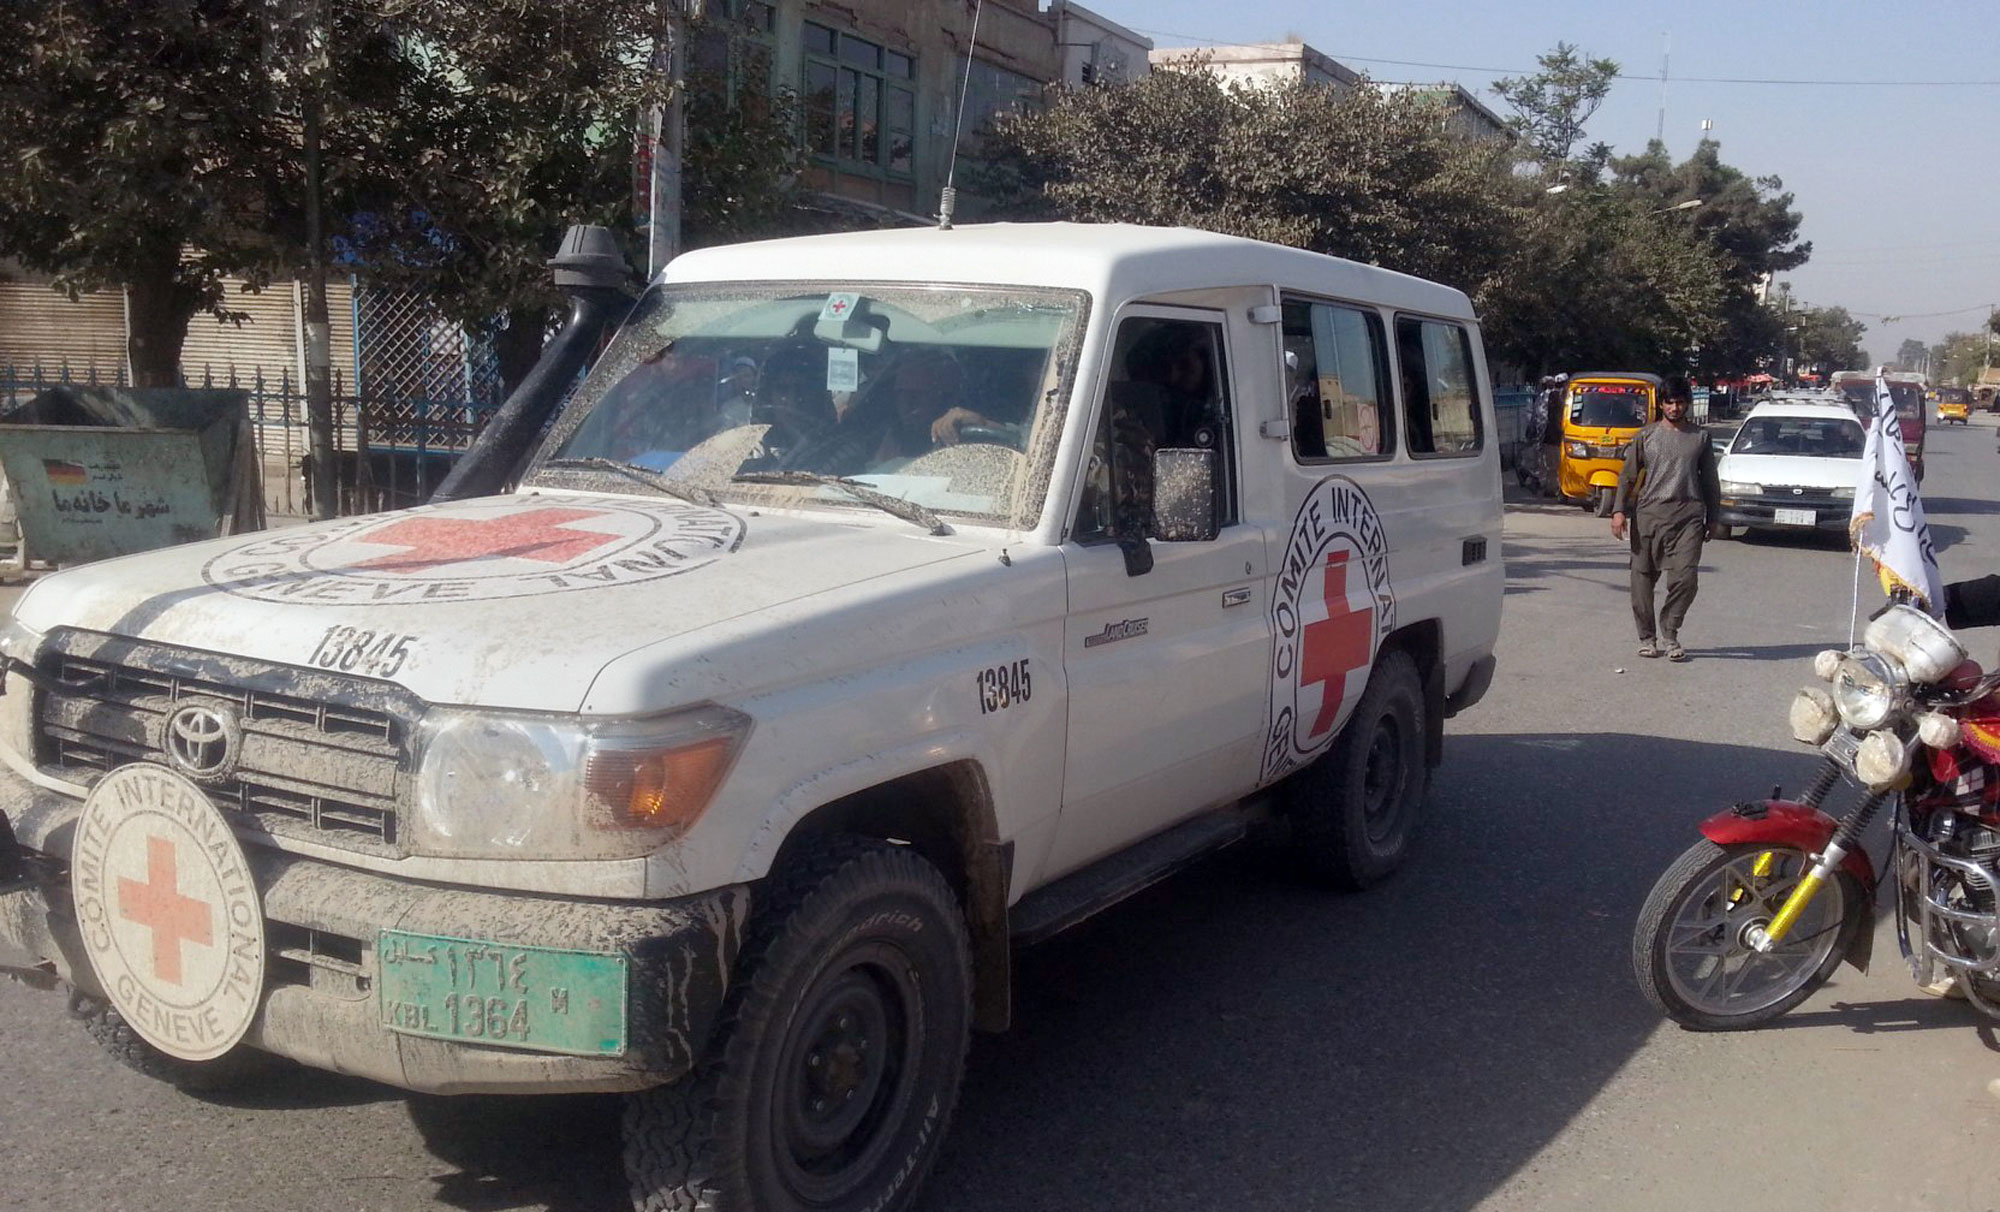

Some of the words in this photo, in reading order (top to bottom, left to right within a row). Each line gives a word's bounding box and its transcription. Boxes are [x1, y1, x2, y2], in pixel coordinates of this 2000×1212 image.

[1277, 499, 1326, 679] COMITE
[307, 624, 420, 678] 13845
[976, 658, 1032, 715] 13845
[81, 803, 112, 952] COMITE
[114, 774, 258, 1002] INTERNATIONAL
[117, 973, 225, 1044] GENEVE
[385, 1000, 440, 1031] KBL
[445, 991, 531, 1041] 1364
